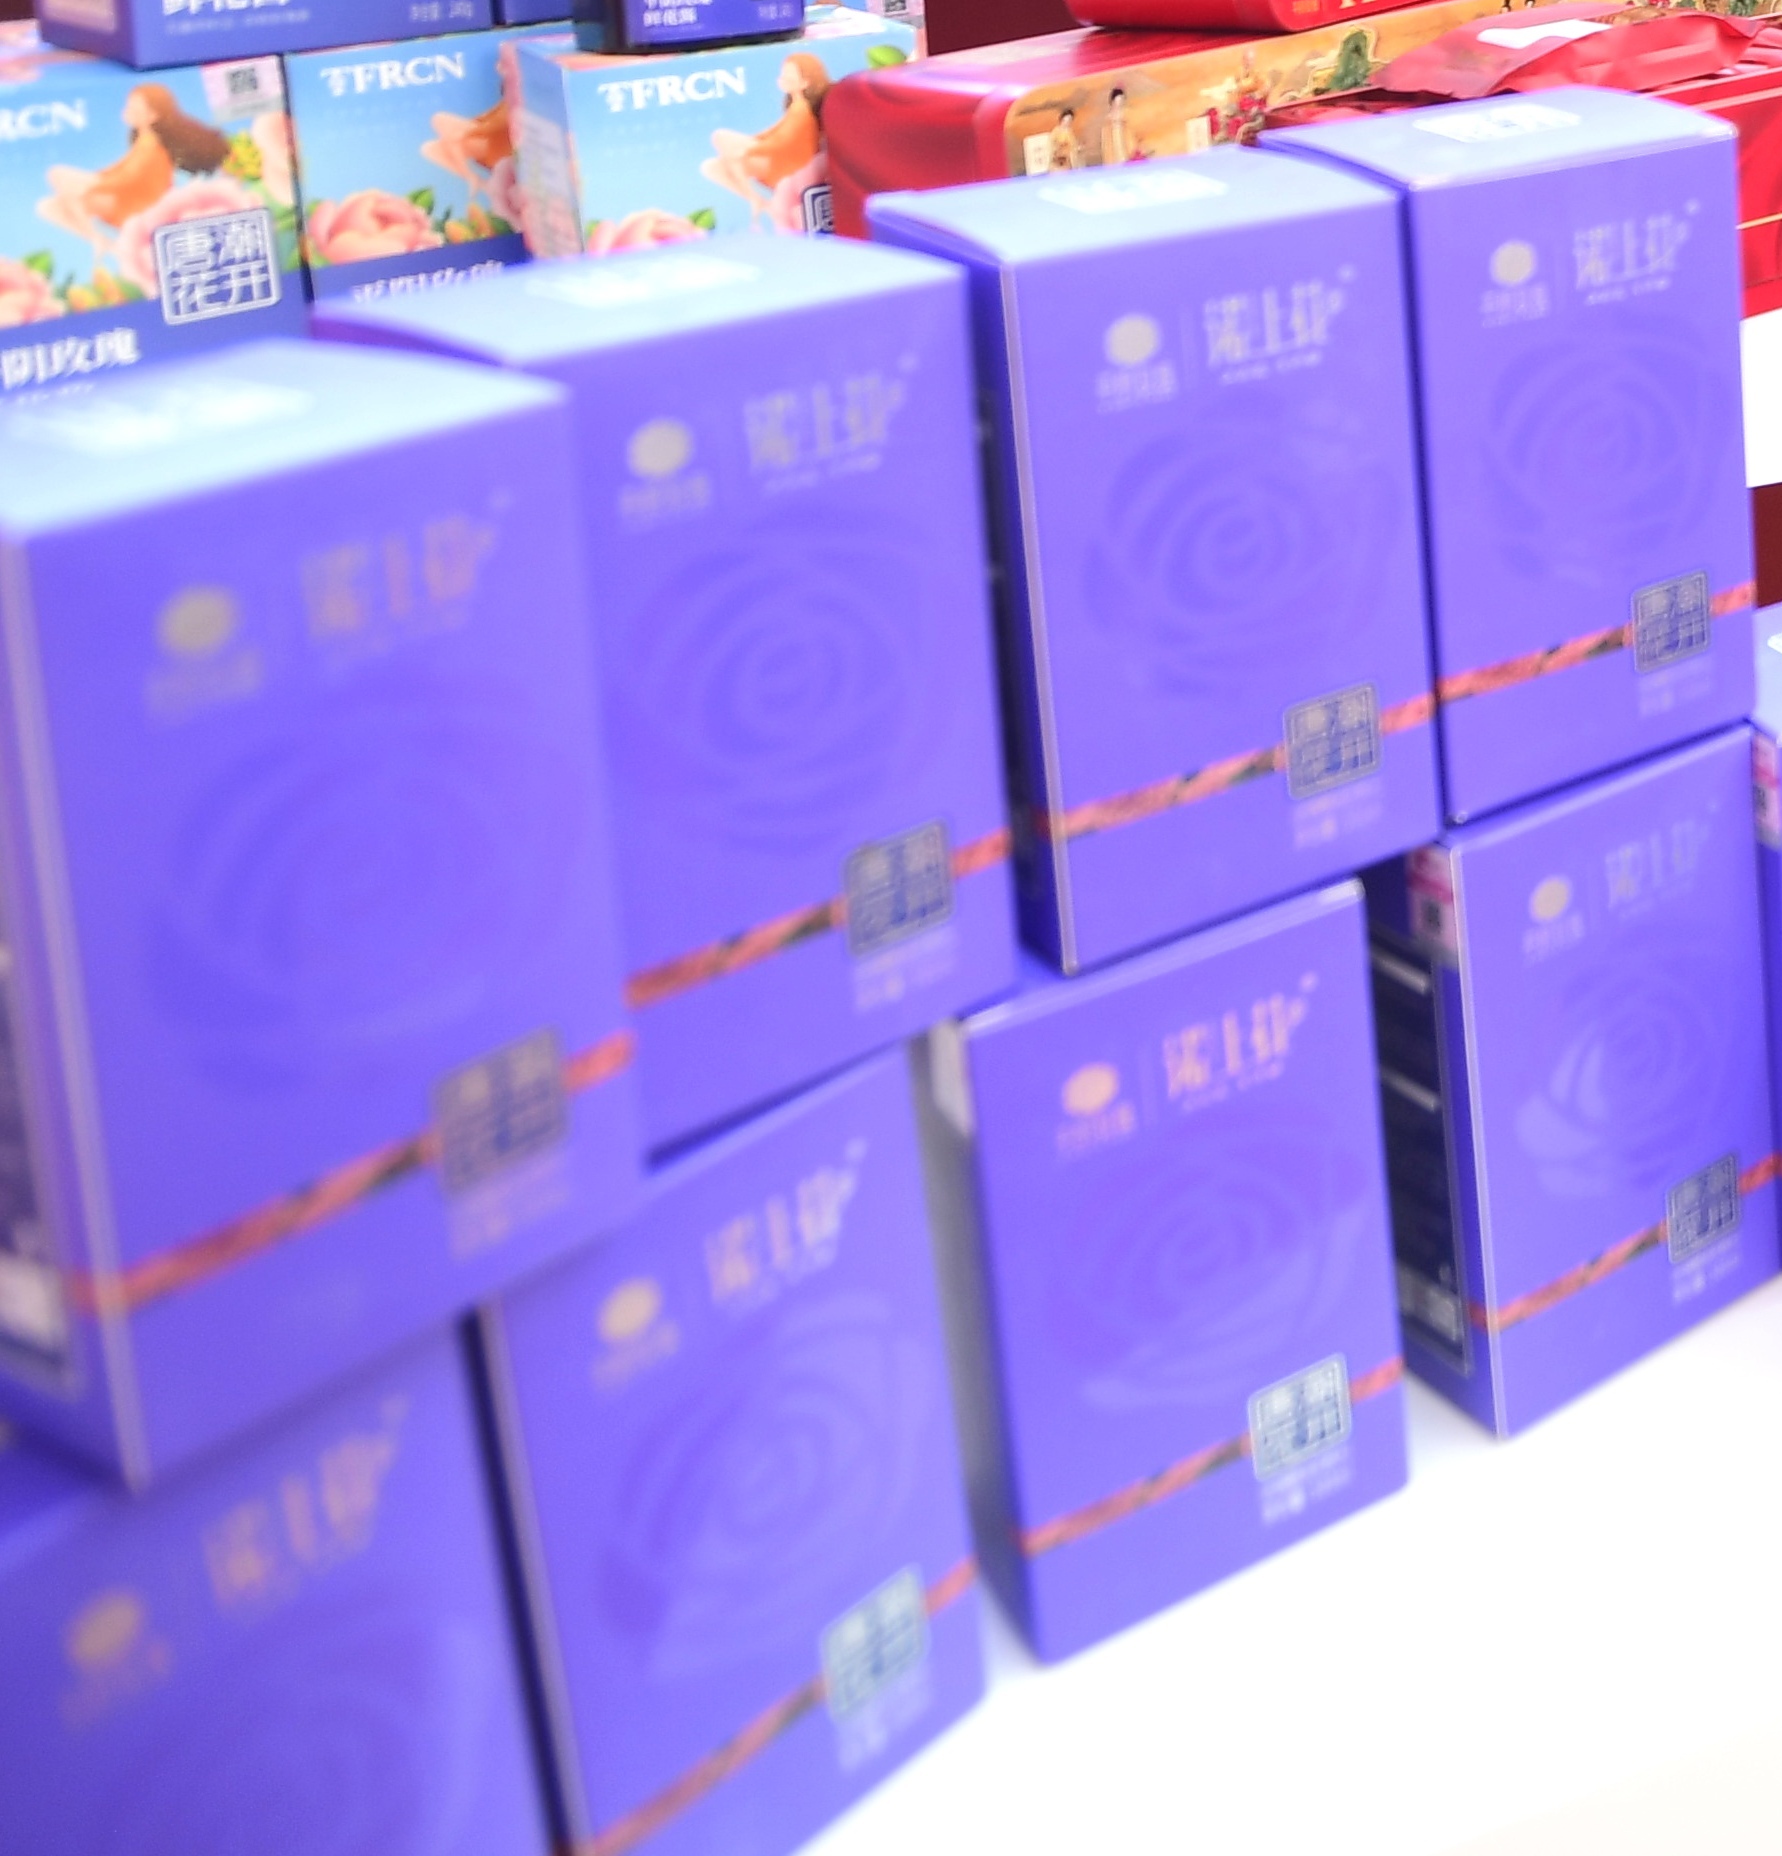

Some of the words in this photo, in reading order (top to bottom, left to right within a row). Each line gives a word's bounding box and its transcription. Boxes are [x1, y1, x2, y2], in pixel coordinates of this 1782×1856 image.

[320, 52, 465, 96] TFRCN
[597, 67, 746, 113] TFRCN
[170, 261, 267, 314] 花开
